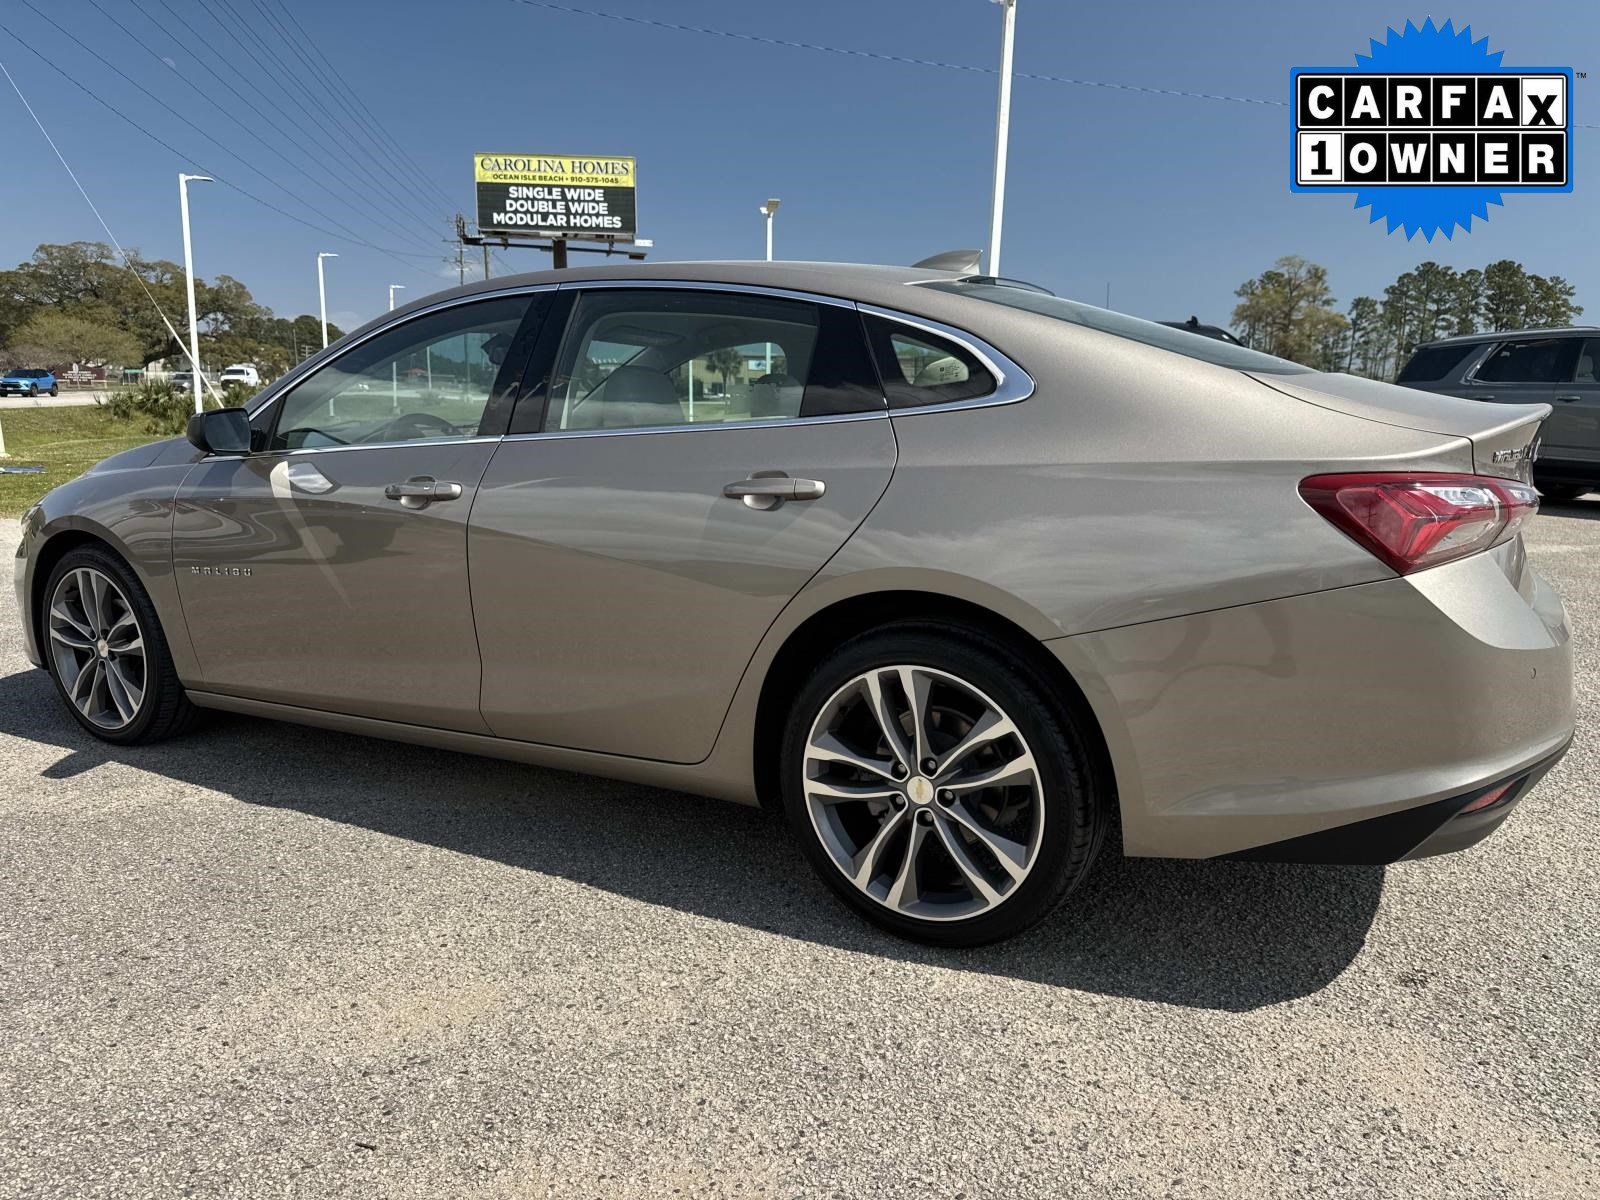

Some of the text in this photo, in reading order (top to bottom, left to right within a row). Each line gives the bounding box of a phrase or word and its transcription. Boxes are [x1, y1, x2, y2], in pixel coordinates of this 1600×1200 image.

[480, 157, 630, 176] CAROLINA HOMES
[492, 173, 519, 181] OCEAN
[570, 176, 619, 184] 910-575-1045
[508, 186, 604, 201] SINGLE WIDE
[505, 199, 608, 215] DOUBLE WIDE
[492, 212, 622, 228] MODULAR HOMES
[191, 566, 252, 577] MALIBU
